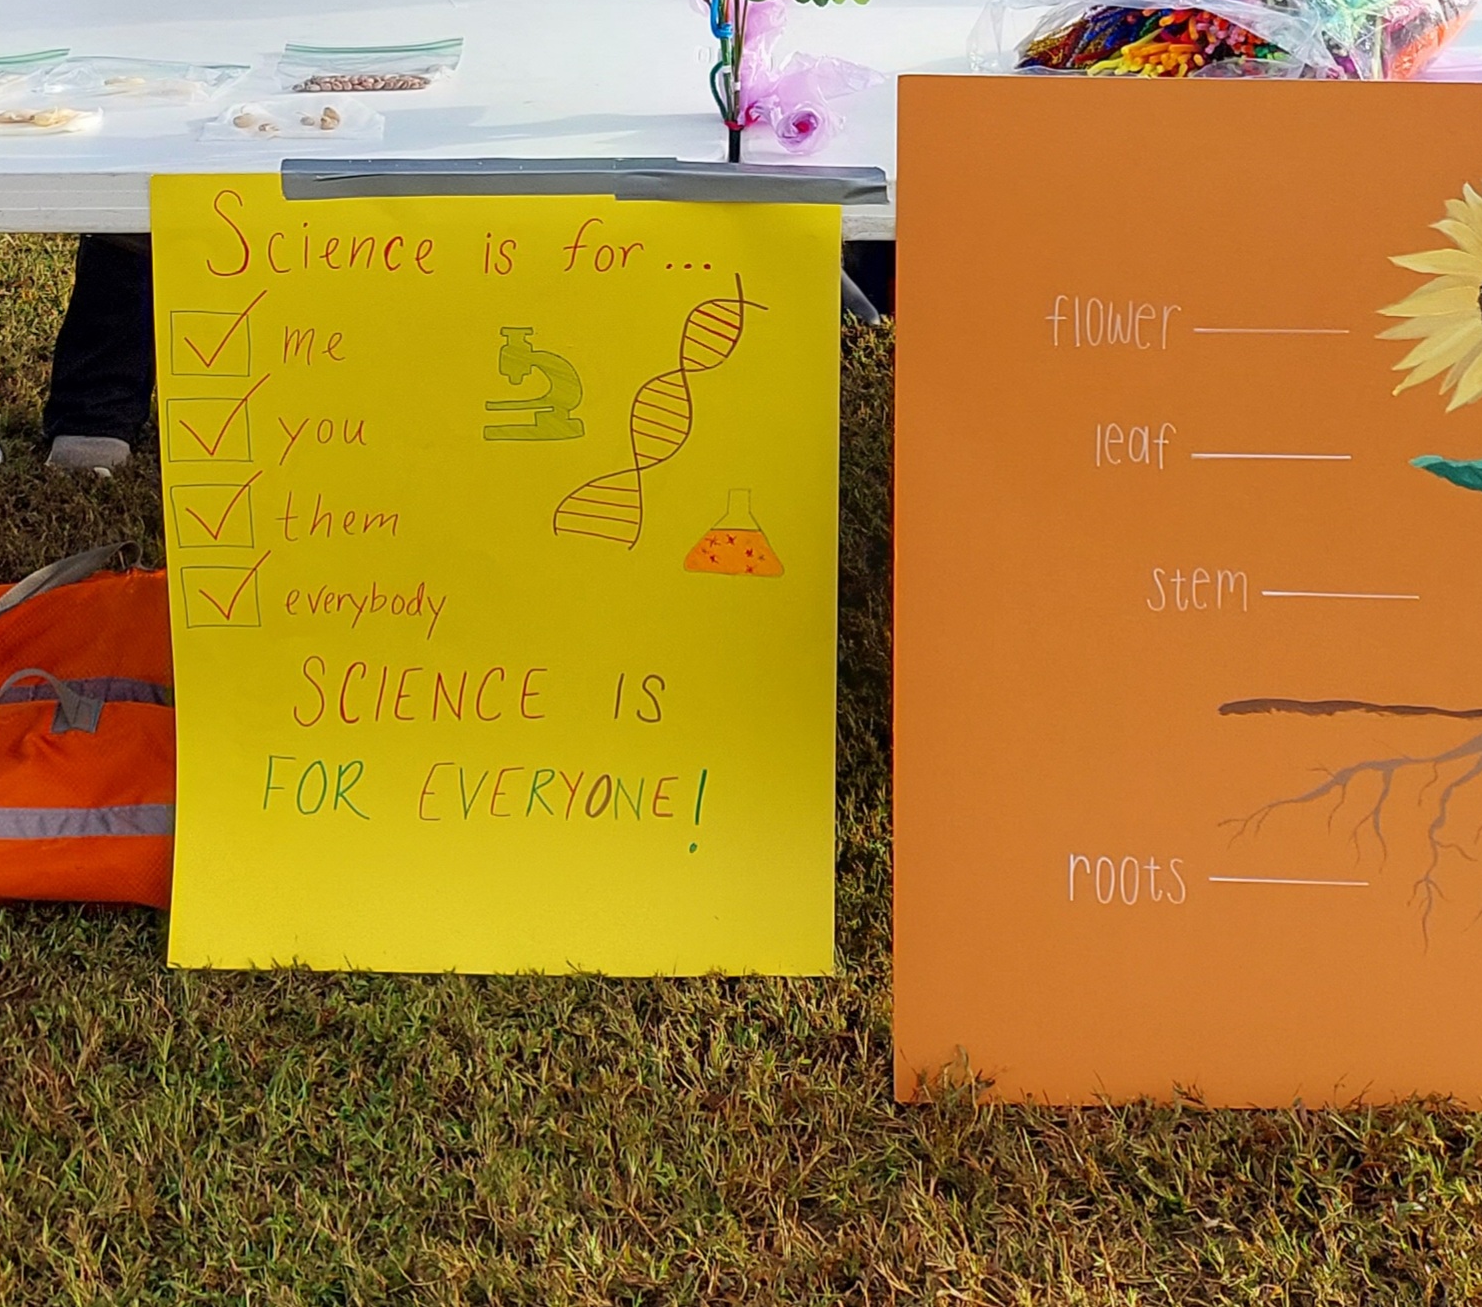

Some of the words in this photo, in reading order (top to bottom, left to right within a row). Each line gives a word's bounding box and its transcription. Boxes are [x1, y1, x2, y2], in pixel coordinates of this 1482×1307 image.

[206, 190, 435, 277] Science
[483, 232, 516, 275] is
[283, 324, 347, 365] me
[1045, 295, 1182, 350] flower
[278, 416, 367, 465] you
[1096, 422, 1177, 470] leaf
[276, 494, 400, 541] them
[284, 581, 447, 640] everybody
[1147, 567, 1248, 612] stem
[293, 656, 548, 727] SCIENCE
[614, 673, 666, 723] IS
[262, 755, 370, 820] FOR
[419, 762, 708, 854] EVERYONE!
[1069, 854, 1187, 905] roots
